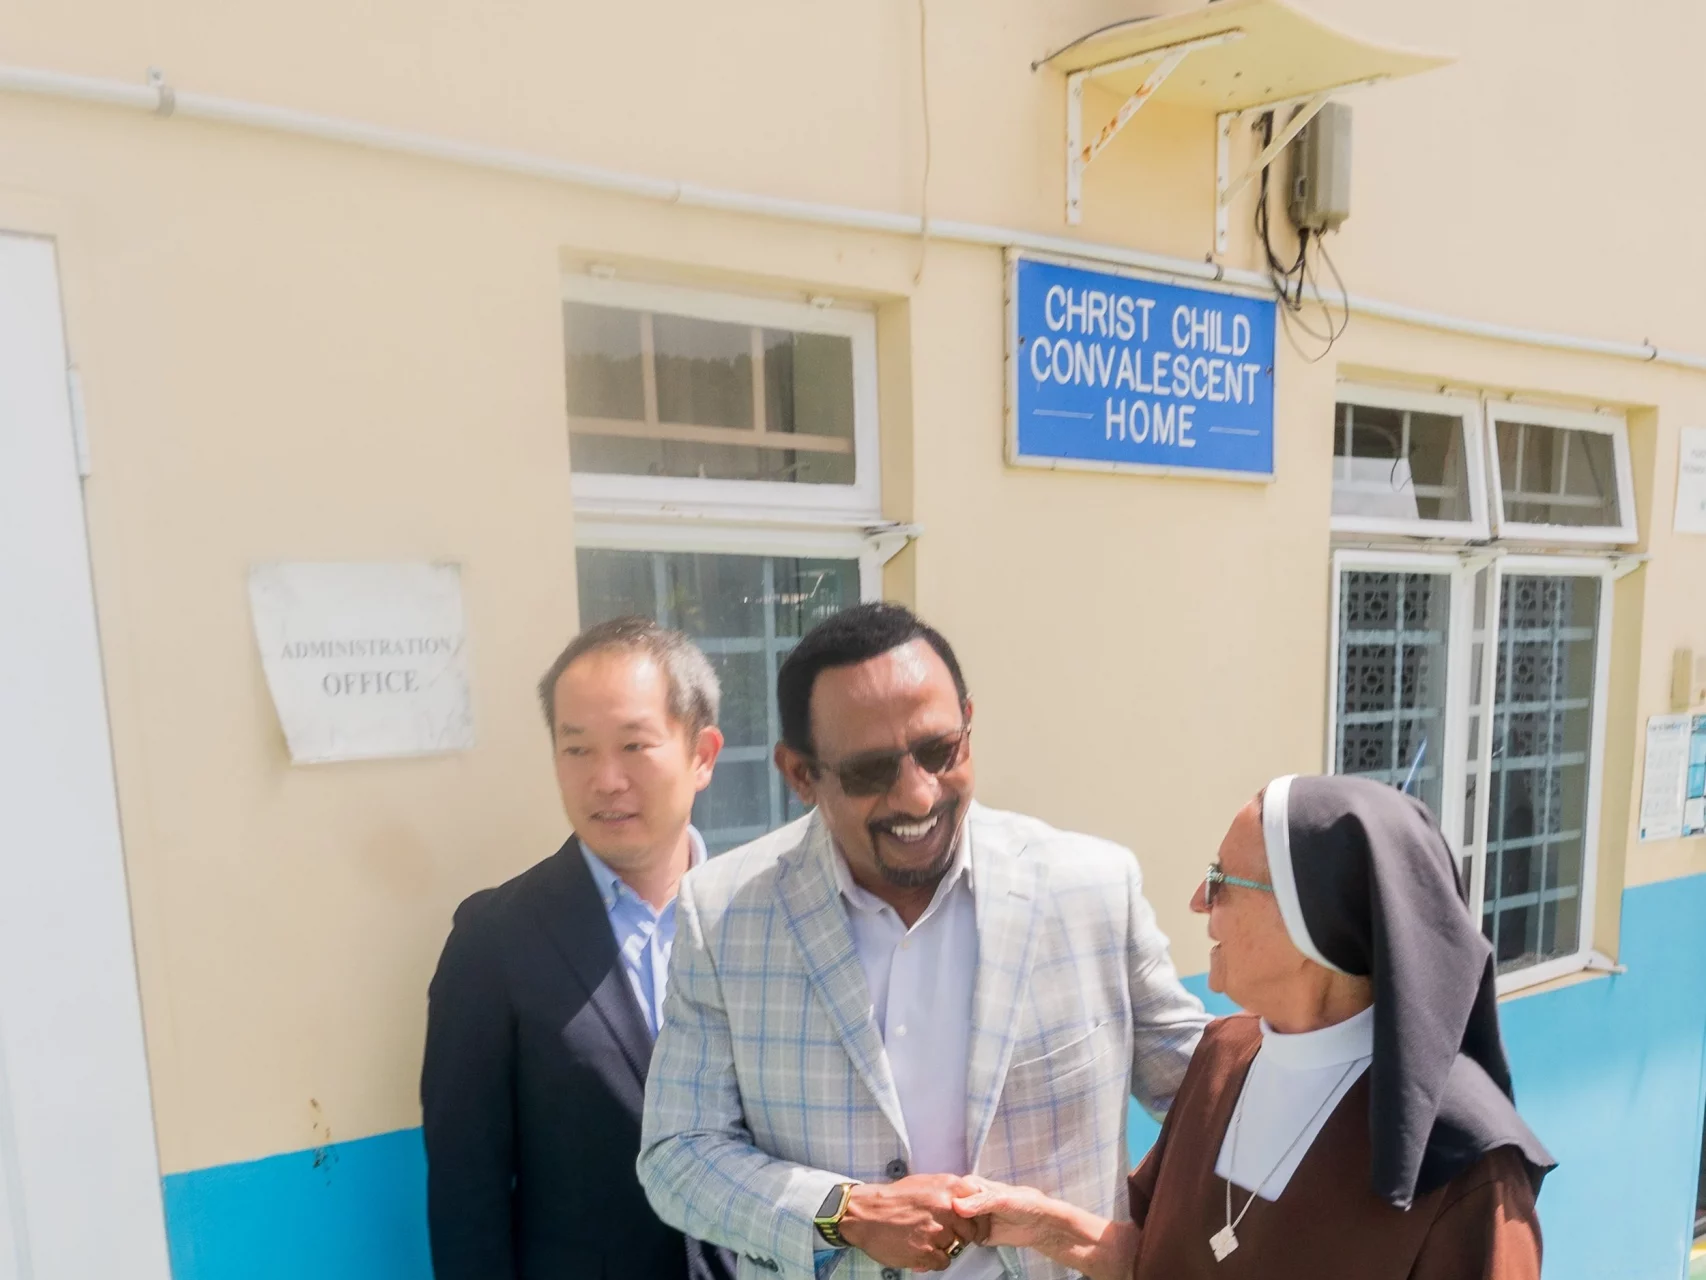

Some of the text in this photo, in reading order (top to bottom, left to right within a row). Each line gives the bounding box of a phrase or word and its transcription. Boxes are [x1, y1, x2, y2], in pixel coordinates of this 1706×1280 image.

[1045, 284, 1250, 357] CHRIST CHILD
[1030, 336, 1260, 405] CONVALESCENT
[1105, 397, 1196, 448] HOME
[280, 637, 451, 660] ADMINISTRATION
[321, 669, 420, 697] OFFICE
